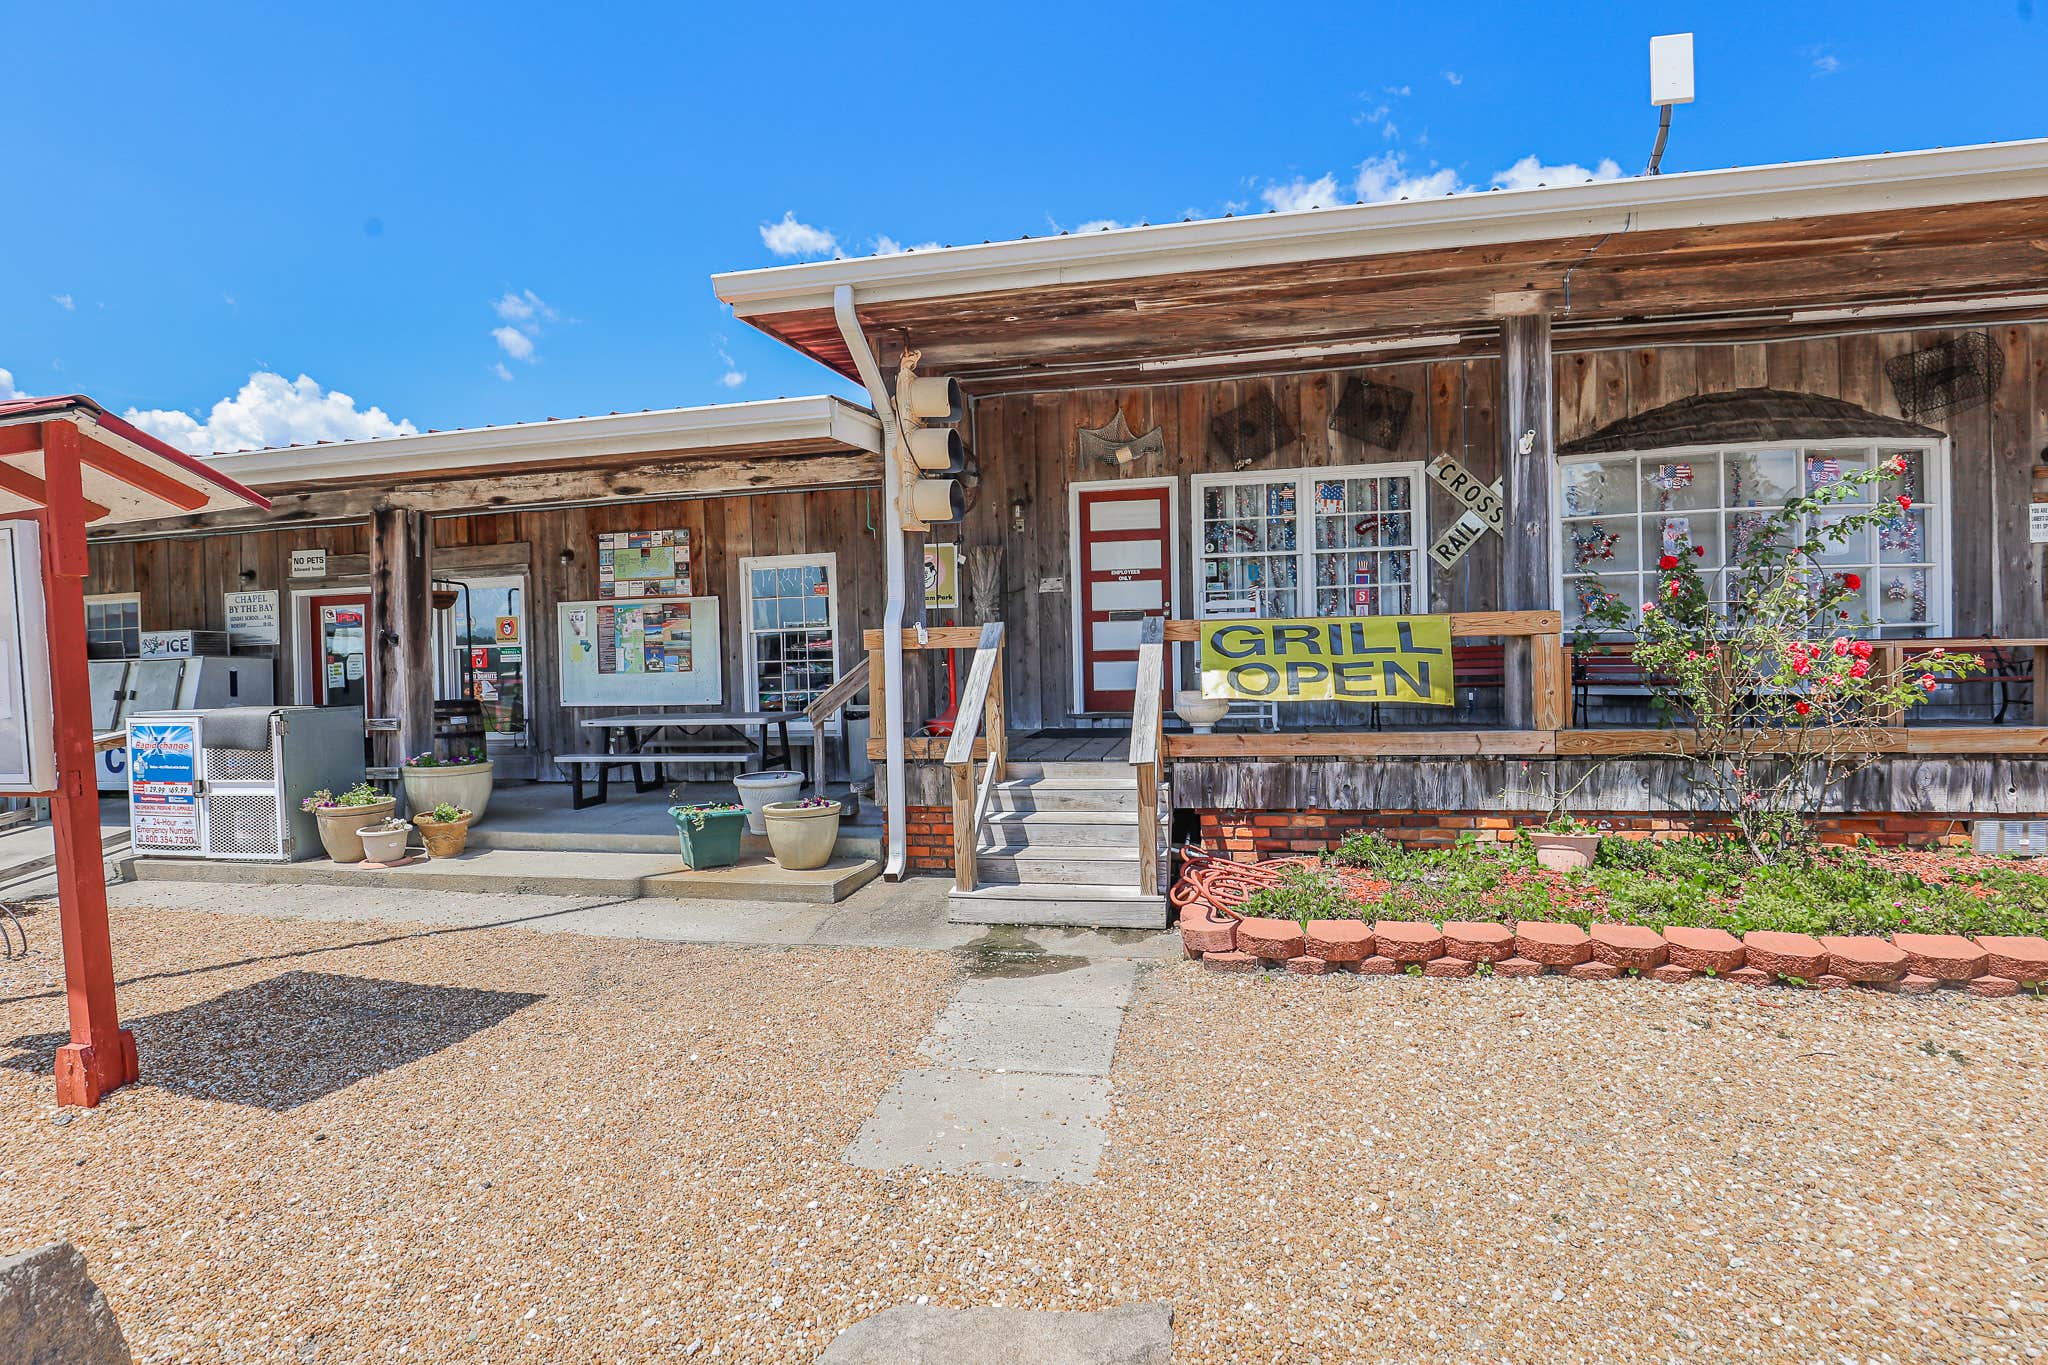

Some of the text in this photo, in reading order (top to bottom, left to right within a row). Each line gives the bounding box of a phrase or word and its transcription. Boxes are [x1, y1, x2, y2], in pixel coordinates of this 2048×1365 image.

[1439, 464, 1503, 531] CROSS
[1436, 522, 1480, 562] RAIL
[294, 557, 304, 565] NO
[235, 594, 268, 604] CHAPEL
[229, 603, 273, 614] BY THE BAY
[166, 638, 190, 653] ICE
[1211, 621, 1443, 659] GRILL
[1226, 661, 1431, 699] OPEN
[152, 817, 177, 827] 24-Hour
[136, 825, 169, 835] Emergency
